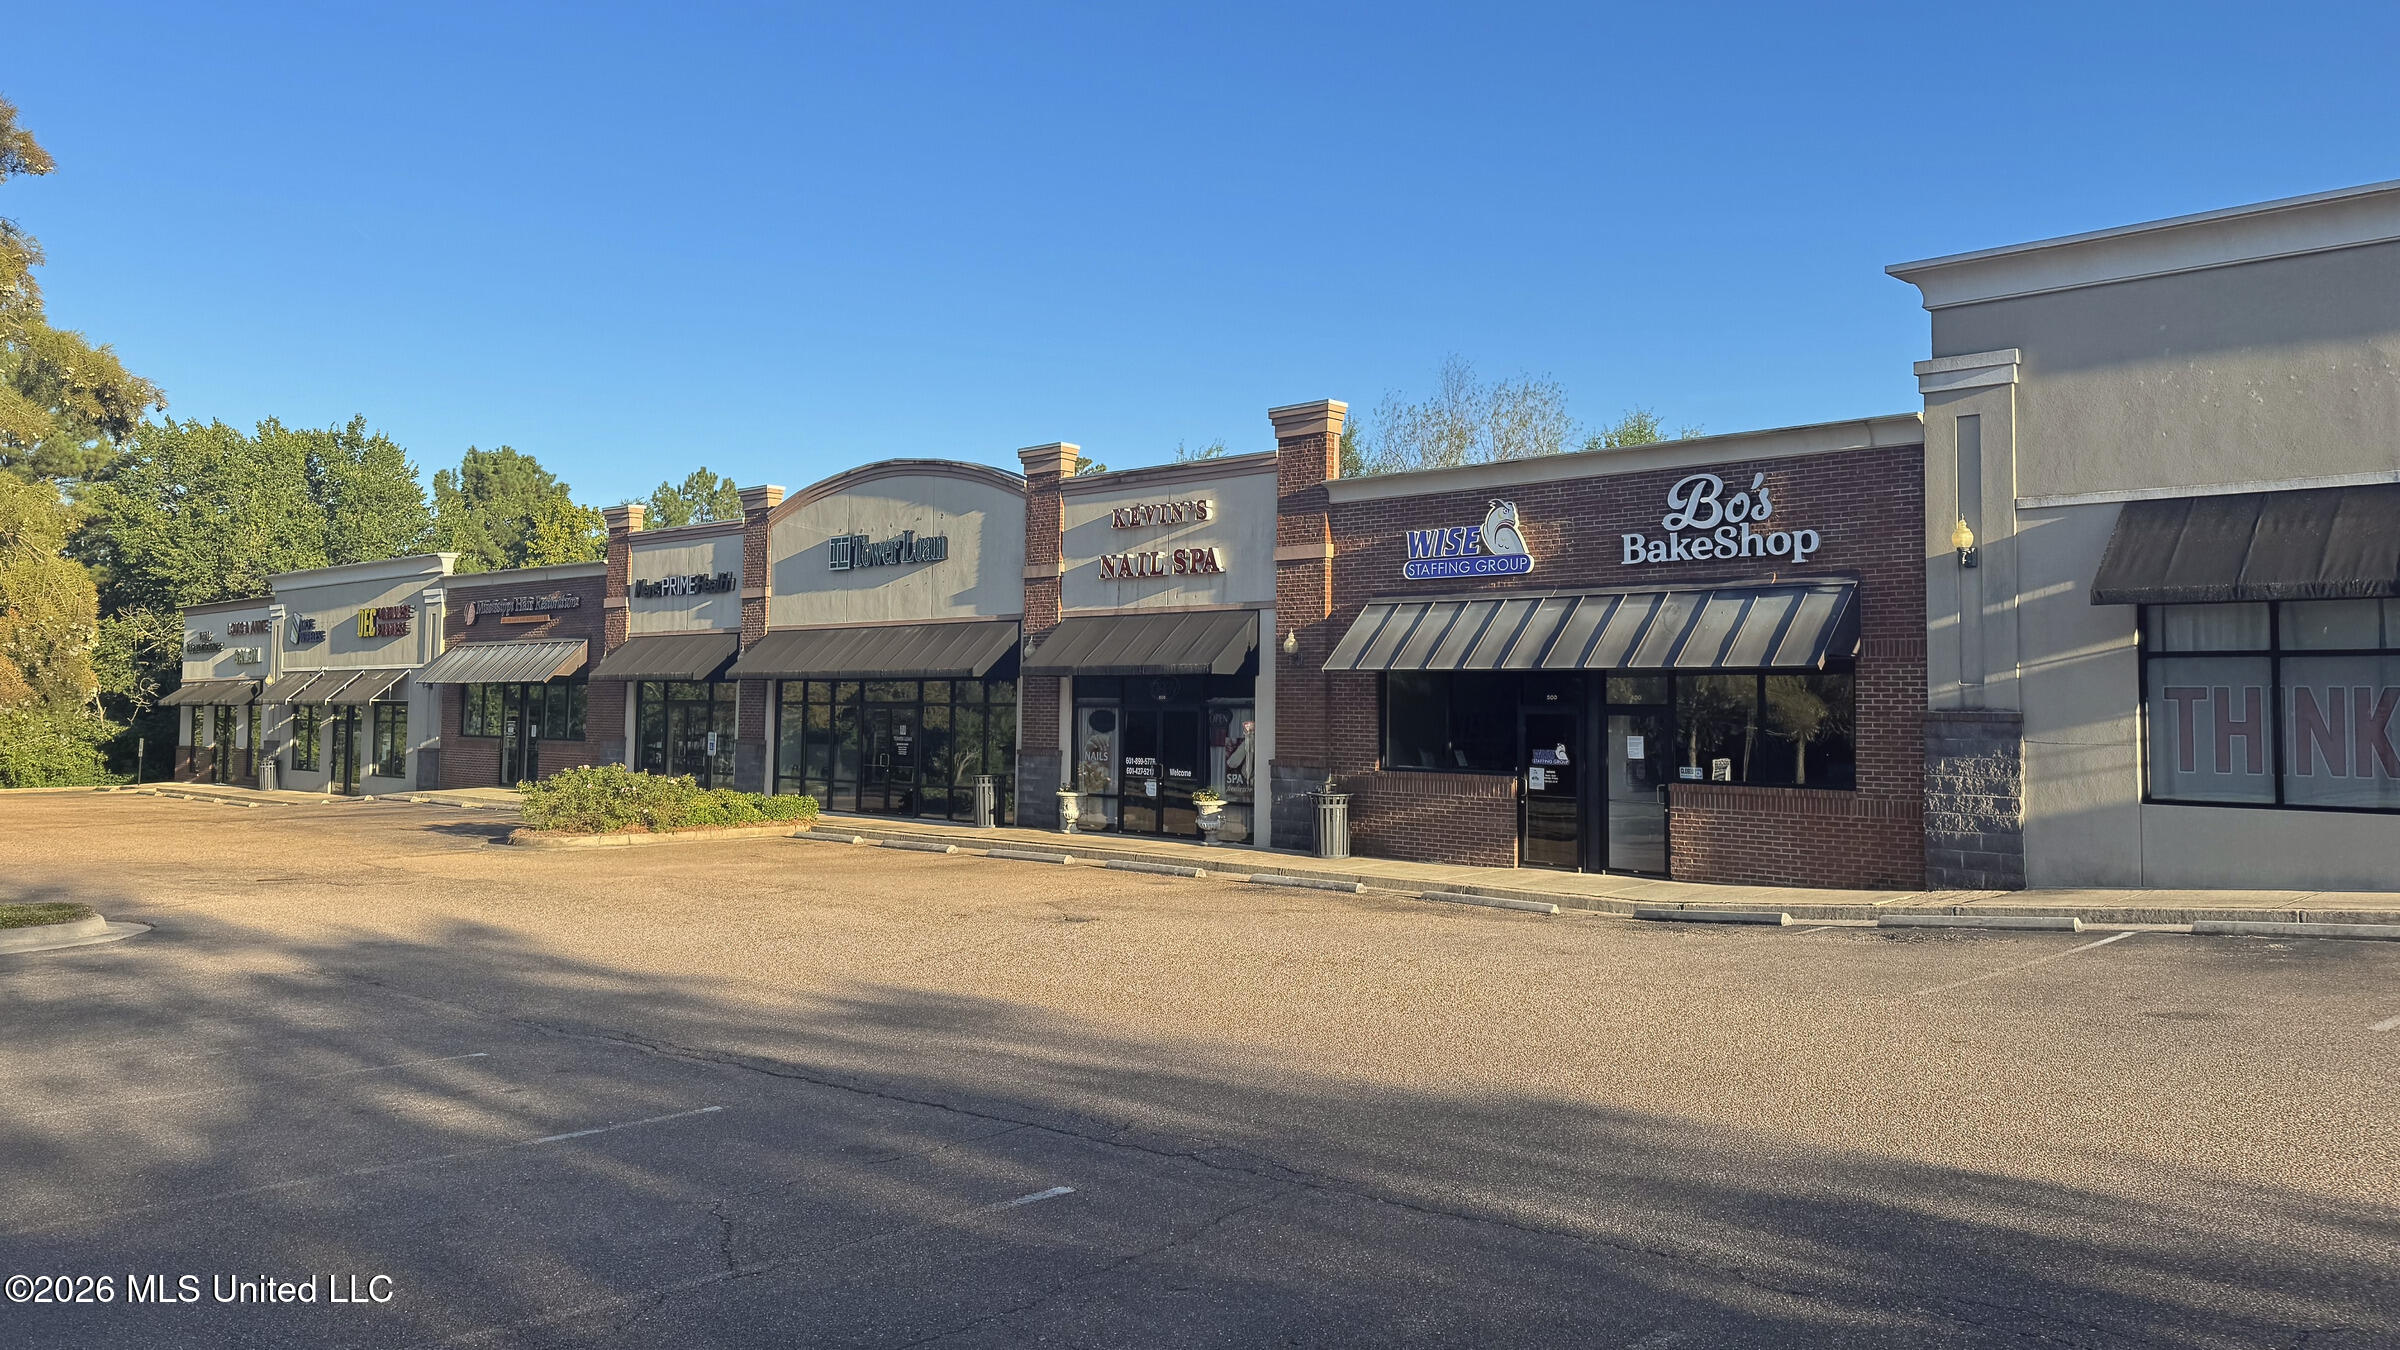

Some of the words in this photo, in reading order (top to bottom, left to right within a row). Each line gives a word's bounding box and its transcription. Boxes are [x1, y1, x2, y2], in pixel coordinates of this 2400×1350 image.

[1111, 499, 1213, 528] KEVIN'S
[1662, 472, 1773, 531] Bo's
[852, 534, 899, 568] Tower
[900, 530, 949, 563] Loan
[1406, 524, 1482, 559] WISE
[1621, 522, 1821, 565] BakeShop
[1099, 551, 1167, 580] NAIL
[1172, 547, 1226, 575] SPA
[1408, 560, 1470, 577] STAFFING
[1475, 556, 1529, 574] GROUP
[661, 575, 697, 596] PRIME
[1085, 751, 1109, 761] NAILS
[1169, 768, 1192, 778] Welcome
[1226, 773, 1244, 784] SPA
